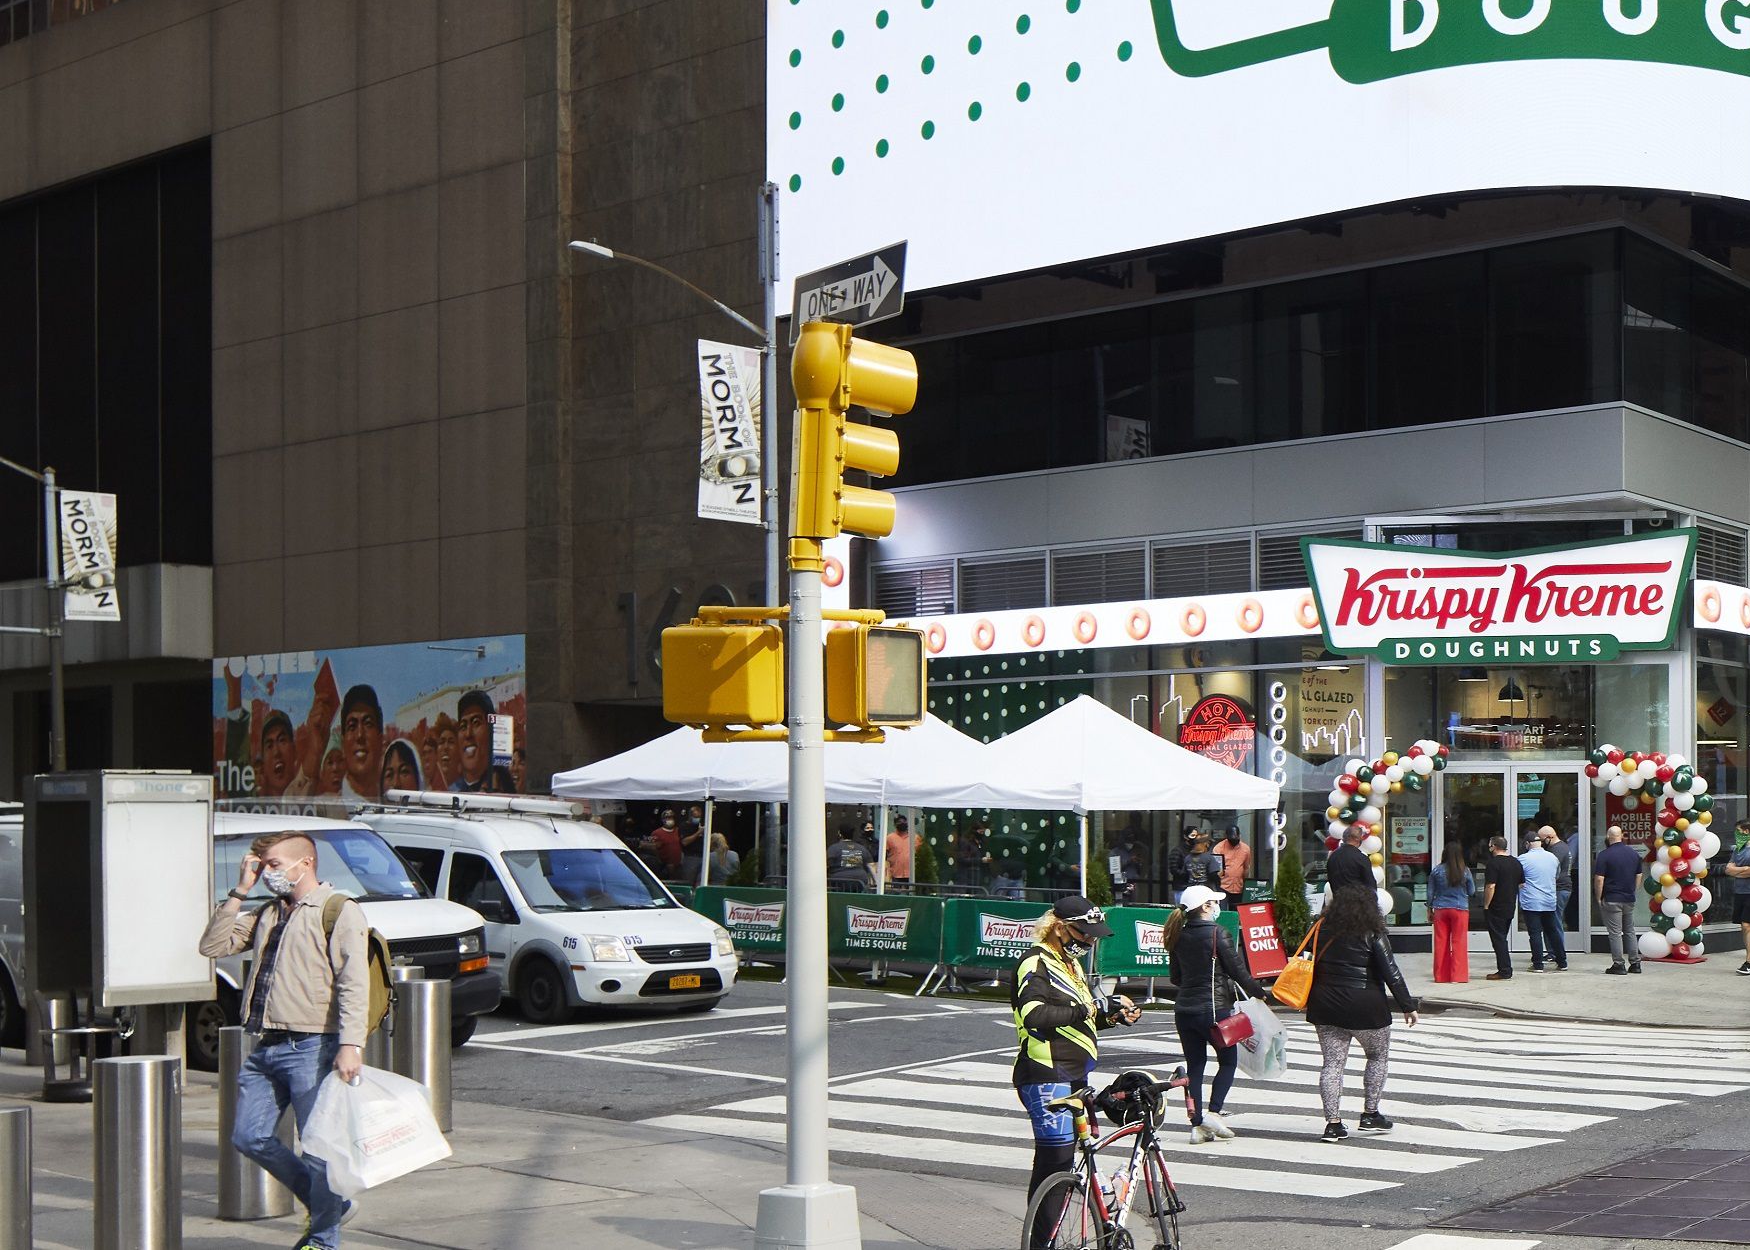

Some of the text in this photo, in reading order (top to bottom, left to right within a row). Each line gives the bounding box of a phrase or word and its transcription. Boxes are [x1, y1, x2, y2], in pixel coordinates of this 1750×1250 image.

[808, 270, 887, 318] ONE WAY
[1335, 560, 1672, 633] Krispy Kreme
[1395, 639, 1602, 659] DOUGHNUTS
[1314, 691, 1354, 704] GLAZED
[1200, 704, 1235, 721] HOT
[1322, 718, 1338, 726] CITY
[1180, 724, 1220, 744] Krispy
[1524, 726, 1544, 734] ART
[1223, 743, 1253, 751] GLAZED
[216, 759, 256, 791] The
[1611, 813, 1651, 822] MOBILE
[1622, 831, 1651, 840] CKUP
[728, 907, 781, 922] Krispy Kreme
[851, 914, 906, 930] Krispy Kreme
[729, 931, 782, 942] MES SQUARE
[985, 922, 1018, 939] Krispy
[1249, 925, 1274, 939] EXIT
[563, 936, 577, 950] 615
[623, 935, 643, 946] 615
[845, 937, 908, 950] TIMES SQUARE
[1249, 938, 1279, 952] ONLY
[976, 947, 1006, 957] TIMES
[1135, 954, 1163, 965] TIMES
